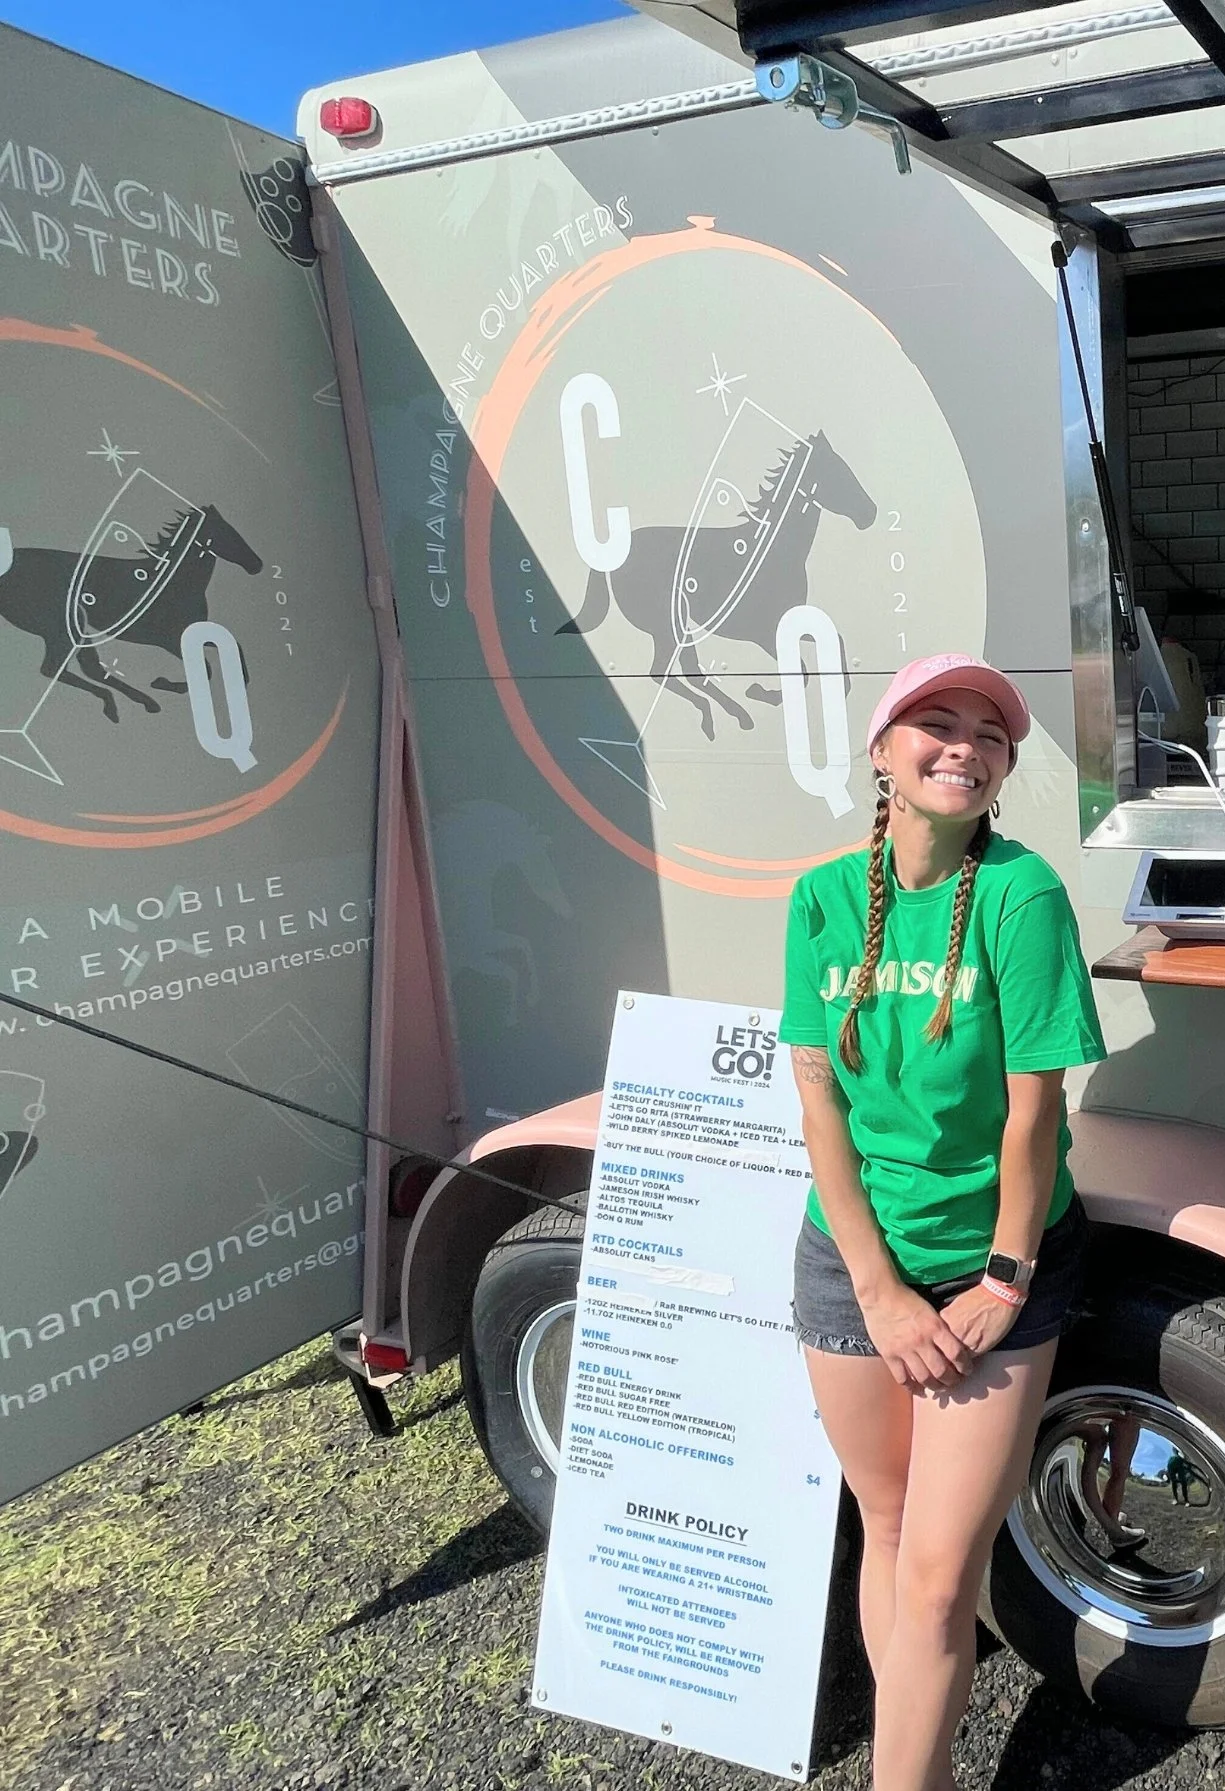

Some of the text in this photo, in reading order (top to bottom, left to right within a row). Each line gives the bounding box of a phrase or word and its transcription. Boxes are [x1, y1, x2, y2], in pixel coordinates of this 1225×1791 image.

[479, 195, 634, 340] QUARTERS
[425, 342, 486, 607] CHAMPAGNE
[559, 372, 632, 573] C
[519, 556, 538, 634] est
[887, 510, 908, 652] 2021
[271, 565, 294, 656] 2021
[180, 621, 258, 774] Q
[775, 605, 856, 819] Q
[18, 876, 285, 945] A MOBILE
[10, 898, 374, 993] R EXPERIENC
[711, 1046, 775, 1081] GO!
[612, 1081, 744, 1108] SPECIALTY COCKTAILS
[753, 1081, 771, 1089] 2024
[631, 1126, 659, 1136] BERRY
[660, 1130, 691, 1141] SPIKED
[693, 1135, 740, 1148] LEMONADE
[636, 1106, 648, 1115] GO
[650, 1108, 669, 1118] RITA
[670, 1112, 731, 1127] (STRAWBERRY
[733, 1120, 786, 1136] MARGARITA)
[601, 1162, 684, 1184] MIXED DRINKS
[642, 1180, 671, 1191] VODKA
[628, 1198, 663, 1210] TEQUILA
[642, 1190, 665, 1200] IRISH
[666, 1194, 700, 1206] WHISKY
[640, 1210, 674, 1222] WHISKY
[592, 1233, 683, 1257] RTD COCKTAILS
[587, 1276, 617, 1290] BEER
[581, 1328, 611, 1342] WINE
[616, 1313, 658, 1327] HEINEKEN
[660, 1321, 673, 1330] 0.0
[578, 1360, 633, 1381] RED BULL
[632, 1350, 652, 1360] PINK
[570, 1423, 734, 1466] NON ALCOHOLIC OFFERINGS
[589, 1468, 605, 1479] TEA
[806, 1474, 820, 1486] $4
[626, 1502, 748, 1541] DRINK POLICY
[604, 1524, 766, 1569] TWO DRINK MAXIMUM PER PERSON
[596, 1544, 769, 1594] YOU WILL ONLY BE SERVED ALCOHOL
[618, 1584, 737, 1620] INTOXICATED ATTENDEES
[627, 1598, 726, 1629] WILL NOT BE SERVED
[584, 1610, 764, 1663] ANYONE WHO DOES NOT COMPLY WITH
[613, 1640, 729, 1677] FROM THE FAIRGROUNDS
[600, 1660, 737, 1703] PLEASE DRINK RESPONSIBLY!
